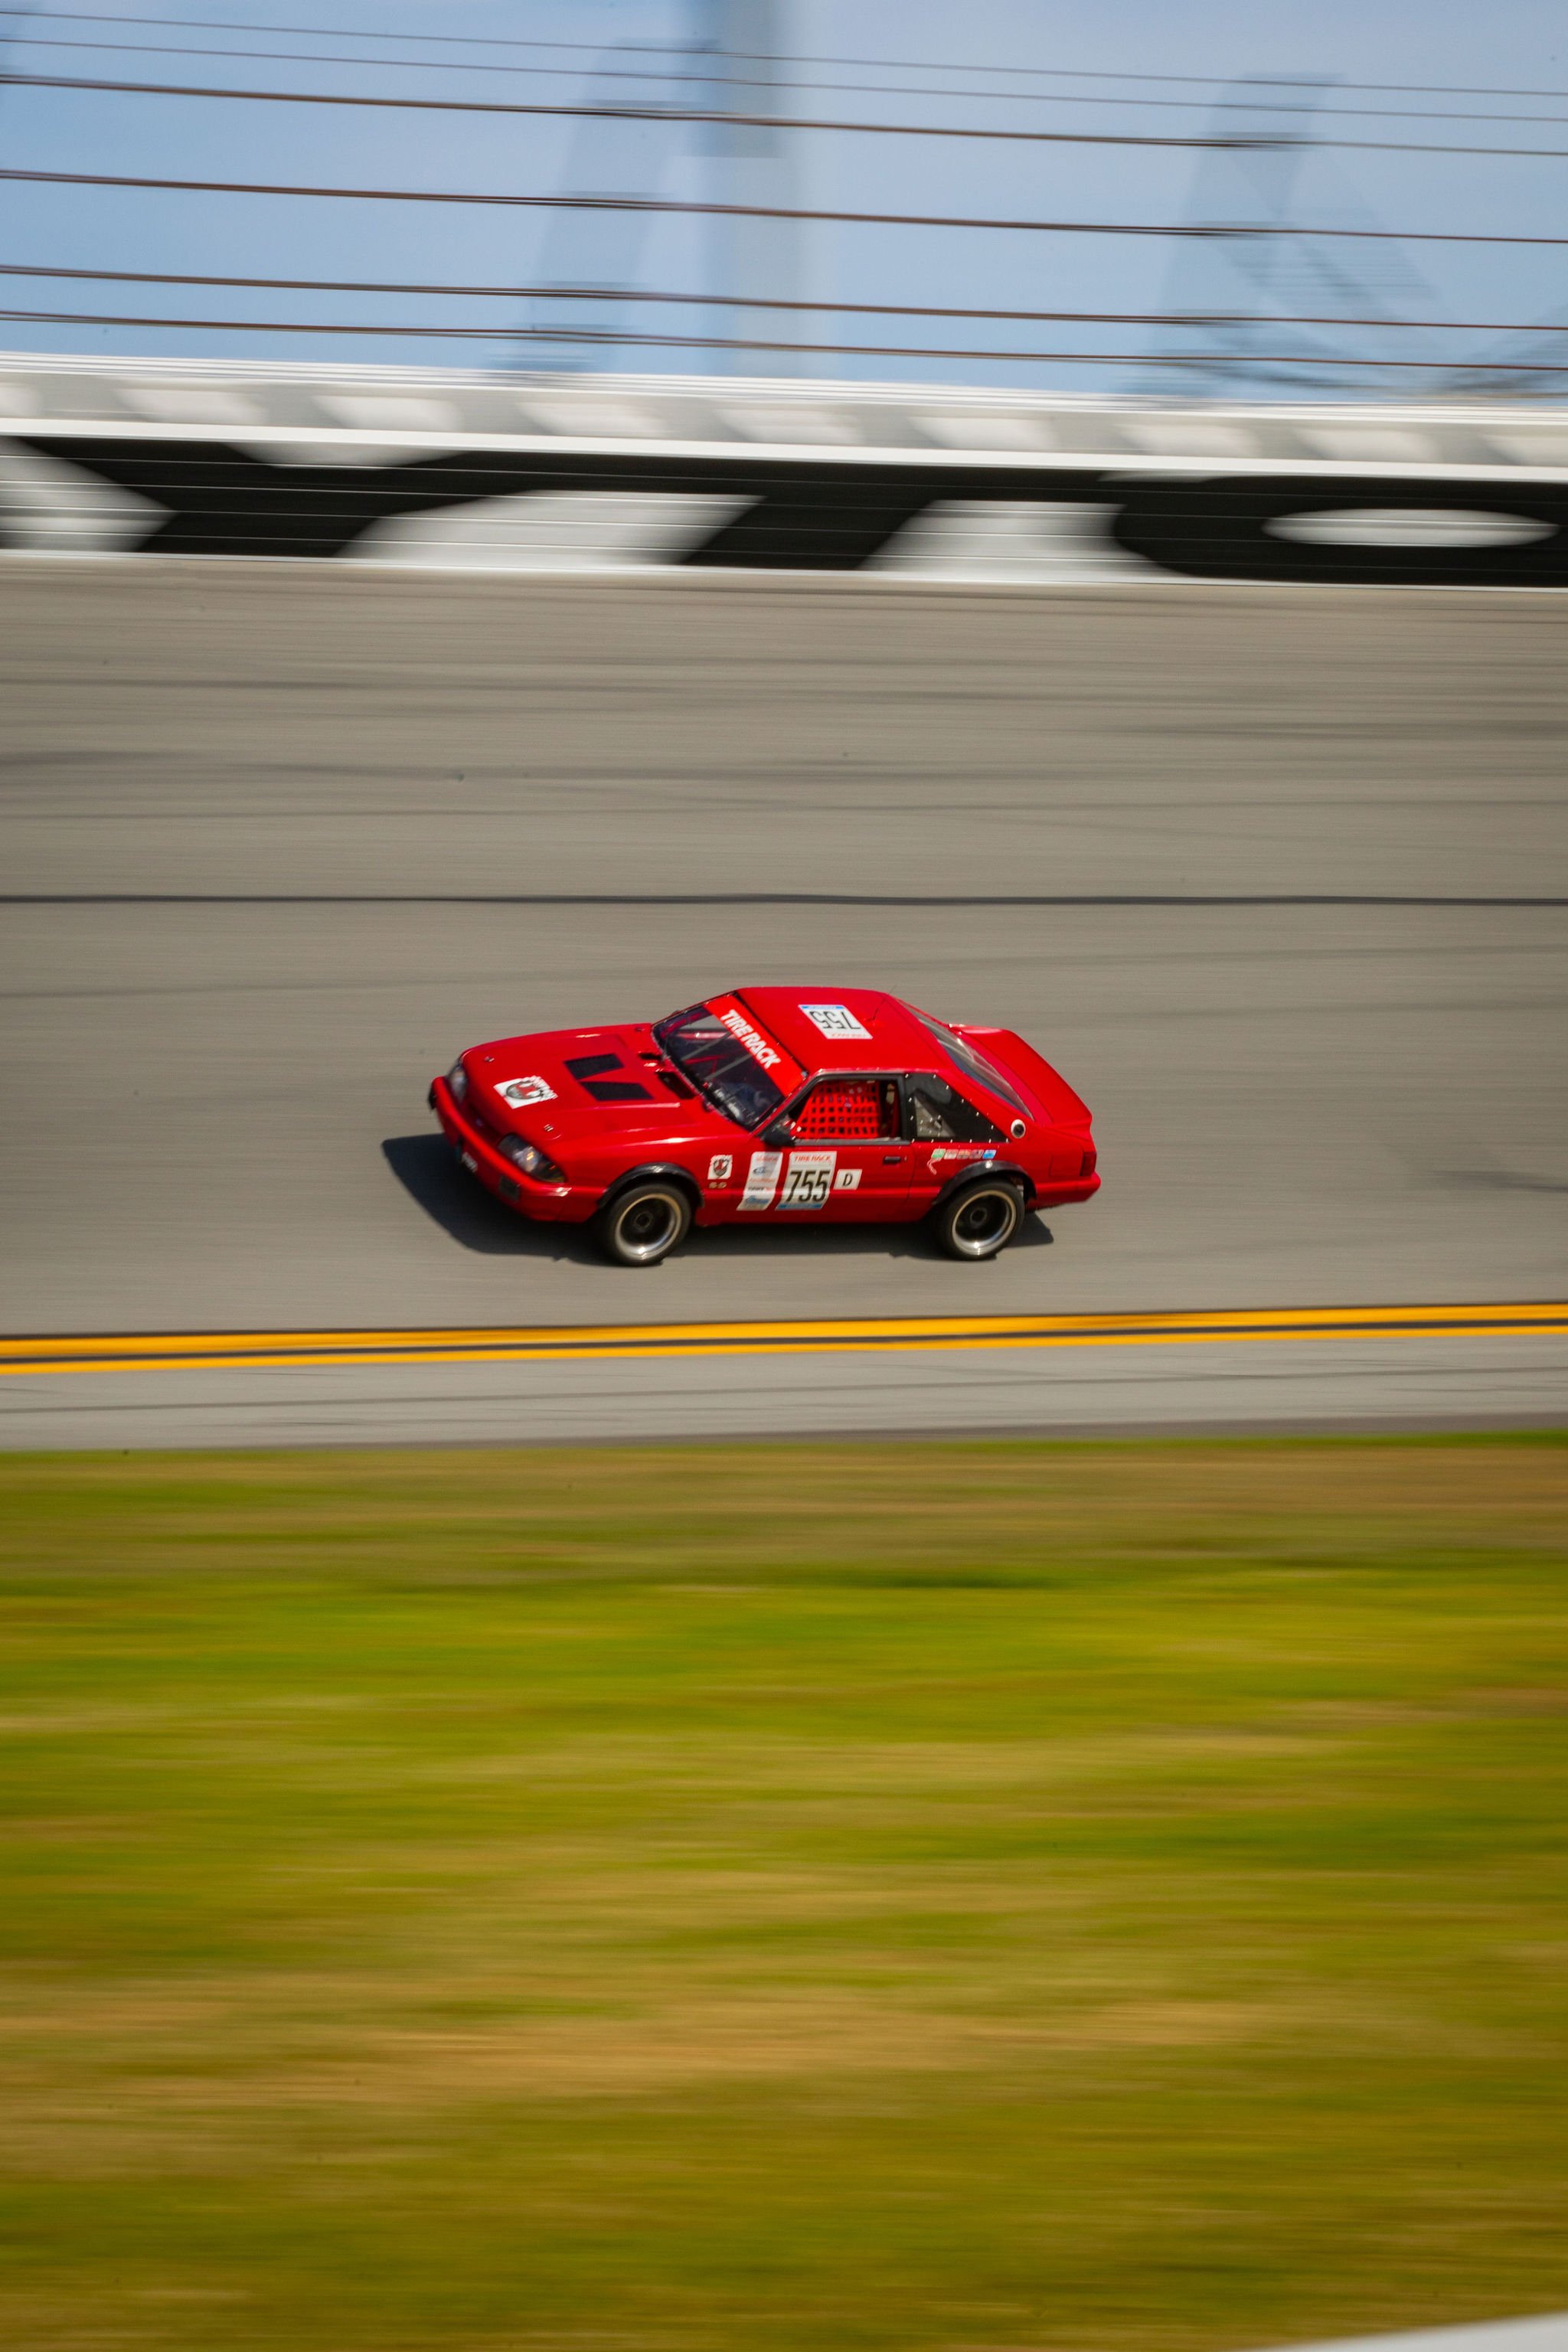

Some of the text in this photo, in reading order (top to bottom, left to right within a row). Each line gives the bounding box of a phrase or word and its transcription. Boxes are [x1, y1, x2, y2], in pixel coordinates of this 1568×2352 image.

[808, 1011, 861, 1029] 755
[720, 1008, 782, 1069] TIRE RACK
[786, 1169, 831, 1202] 755
[842, 1172, 854, 1186] D
